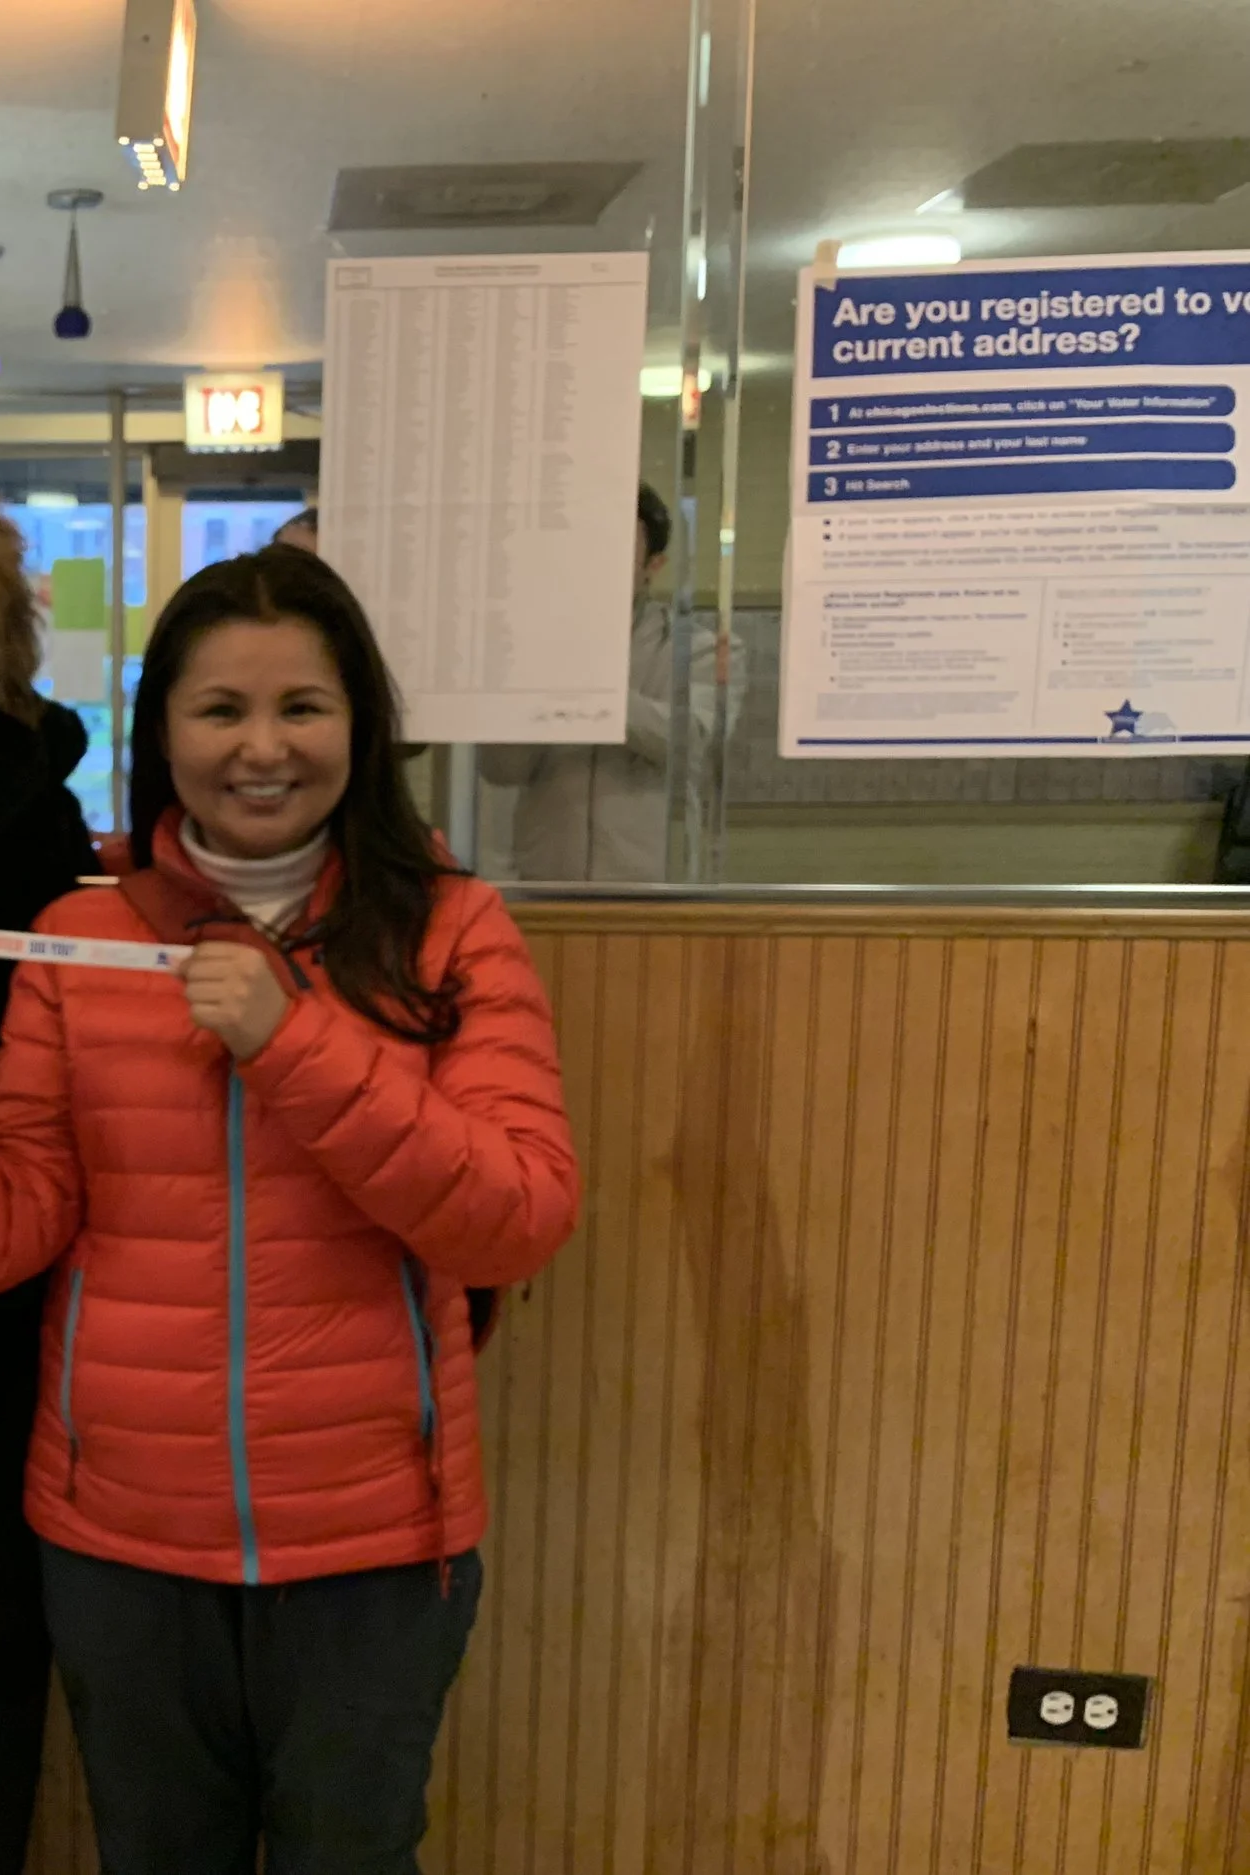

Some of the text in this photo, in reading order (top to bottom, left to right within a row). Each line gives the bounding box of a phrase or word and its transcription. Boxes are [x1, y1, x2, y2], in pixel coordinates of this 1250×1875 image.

[832, 297, 896, 327] Are
[905, 297, 970, 330] you
[980, 287, 1164, 327] registered
[1174, 287, 1212, 315] to
[832, 323, 1142, 364] current address?
[828, 403, 840, 422] 1
[826, 439, 842, 460] 2
[824, 476, 839, 496] 3
